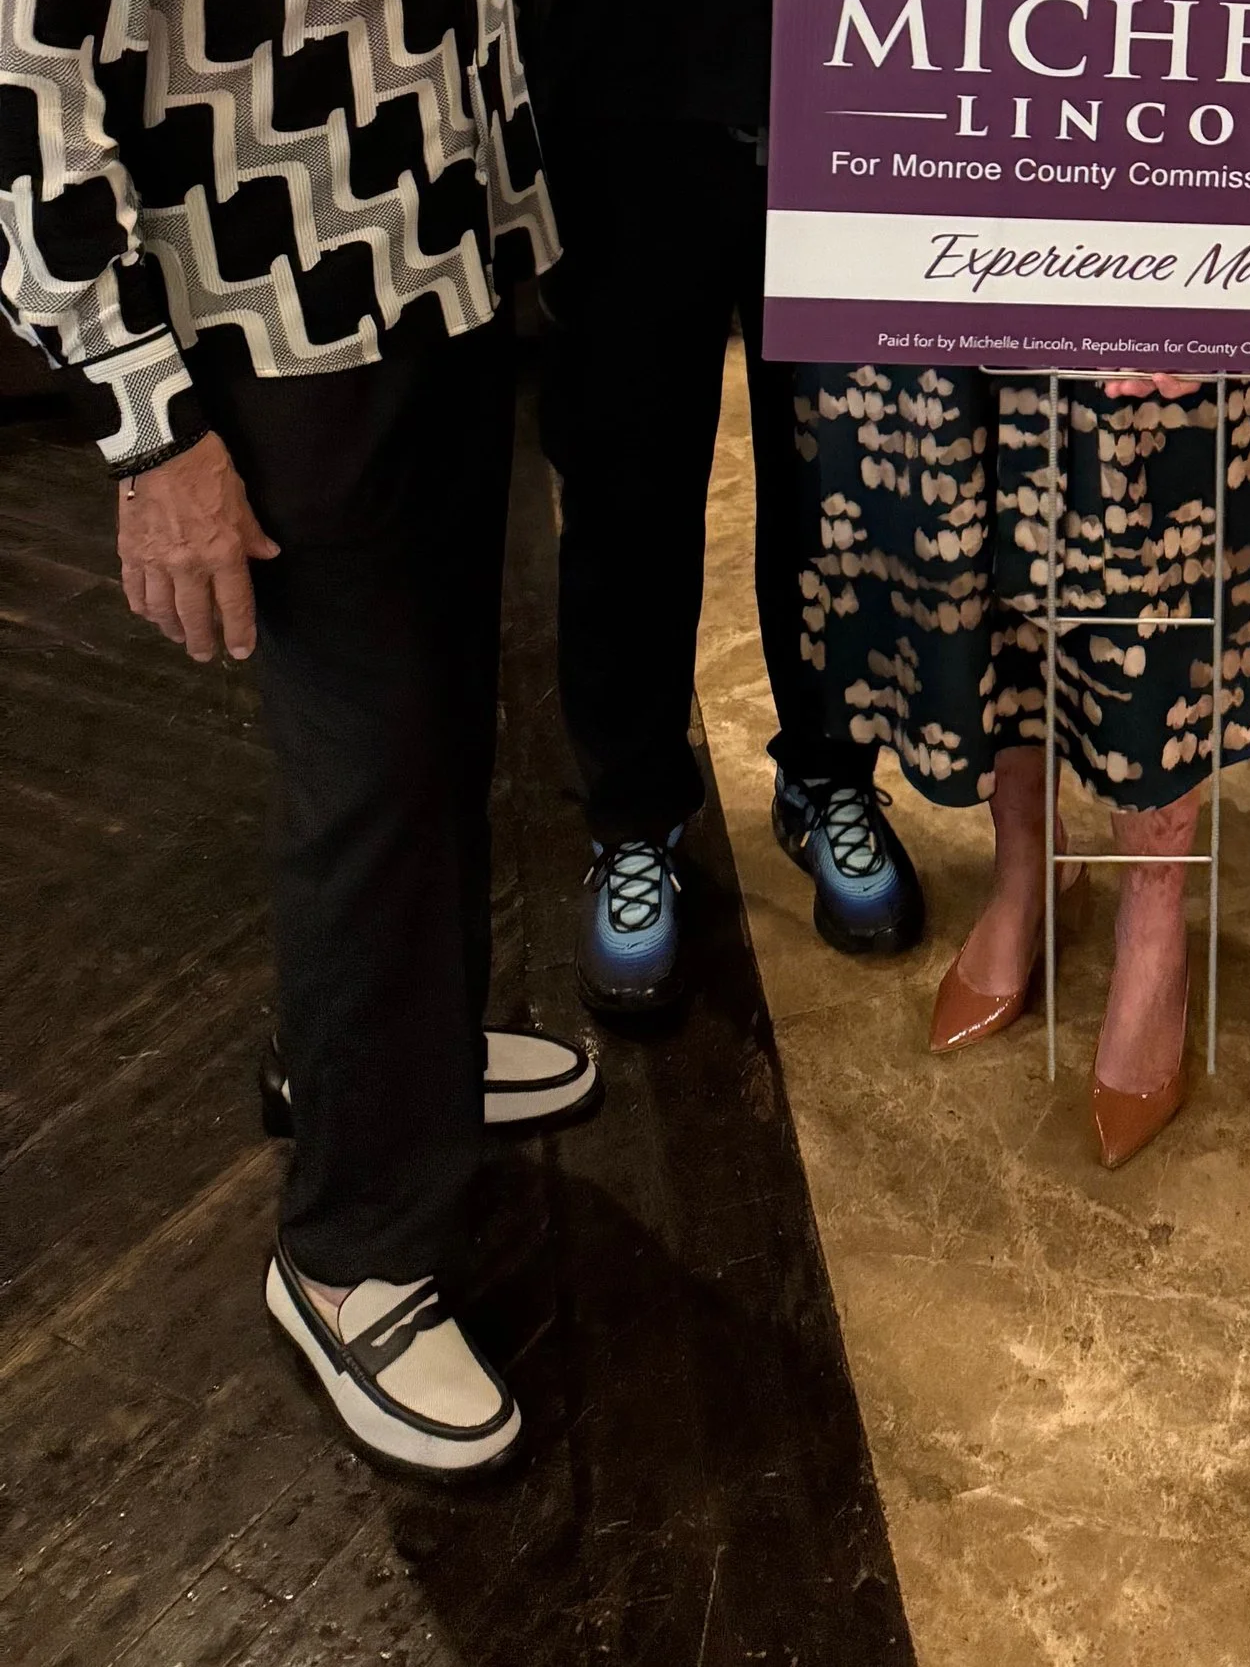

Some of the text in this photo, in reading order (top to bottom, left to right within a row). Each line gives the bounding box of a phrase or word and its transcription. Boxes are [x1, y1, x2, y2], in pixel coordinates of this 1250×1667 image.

[831, 151, 881, 177] For
[892, 153, 1002, 181] Monroe
[1014, 157, 1117, 191] County
[923, 233, 1178, 294] Experience
[877, 333, 910, 347] Paid
[913, 333, 935, 348] for
[937, 334, 956, 352] by
[959, 335, 1020, 350] Michelle
[1022, 336, 1078, 352] Lincoln,
[1081, 337, 1160, 356] Republican
[1163, 338, 1183, 353] for
[1186, 340, 1238, 358] County
